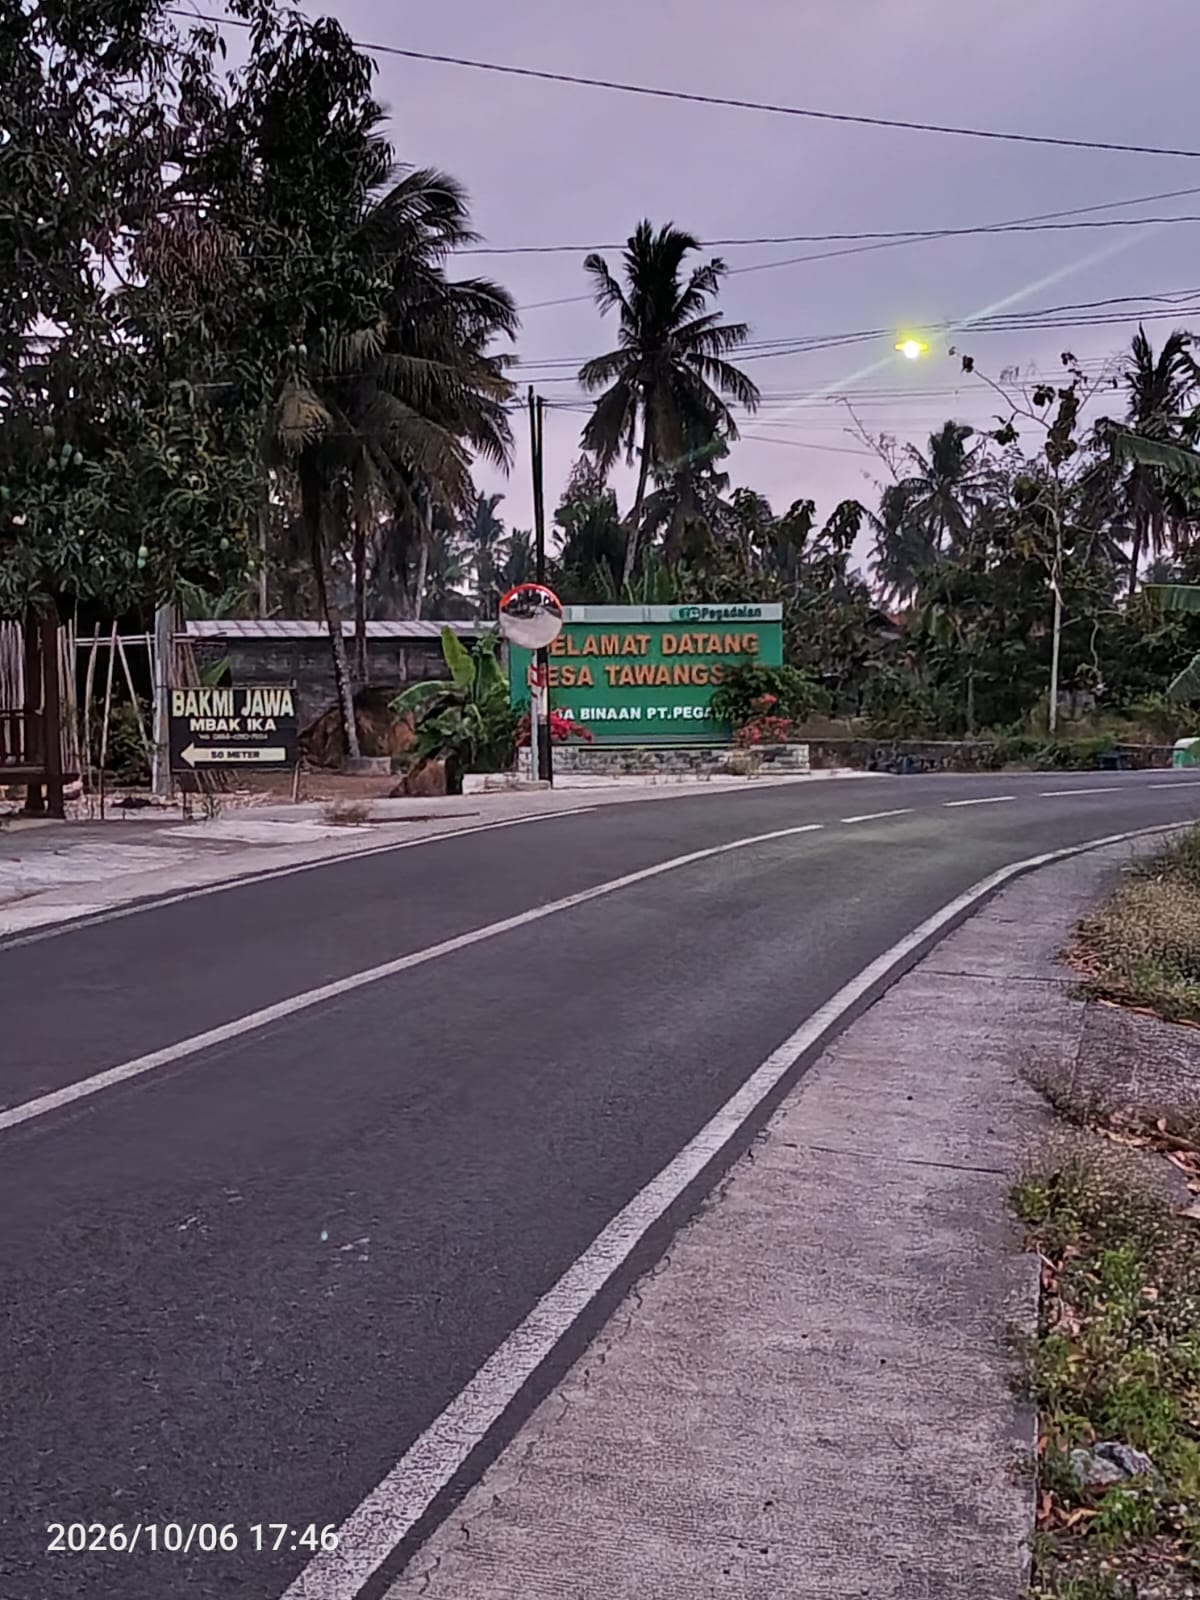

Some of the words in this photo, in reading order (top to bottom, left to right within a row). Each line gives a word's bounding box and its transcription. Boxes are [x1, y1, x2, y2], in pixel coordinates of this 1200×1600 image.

[547, 634, 651, 656] ELAMAT
[661, 633, 759, 655] DATANG
[605, 663, 724, 686] TAWANGS
[172, 690, 235, 717] BAKMI
[241, 690, 294, 717] JAWA
[580, 706, 641, 720] BINAAN
[189, 718, 241, 732] MBAK
[247, 718, 277, 732] IKA
[227, 750, 260, 759] METER
